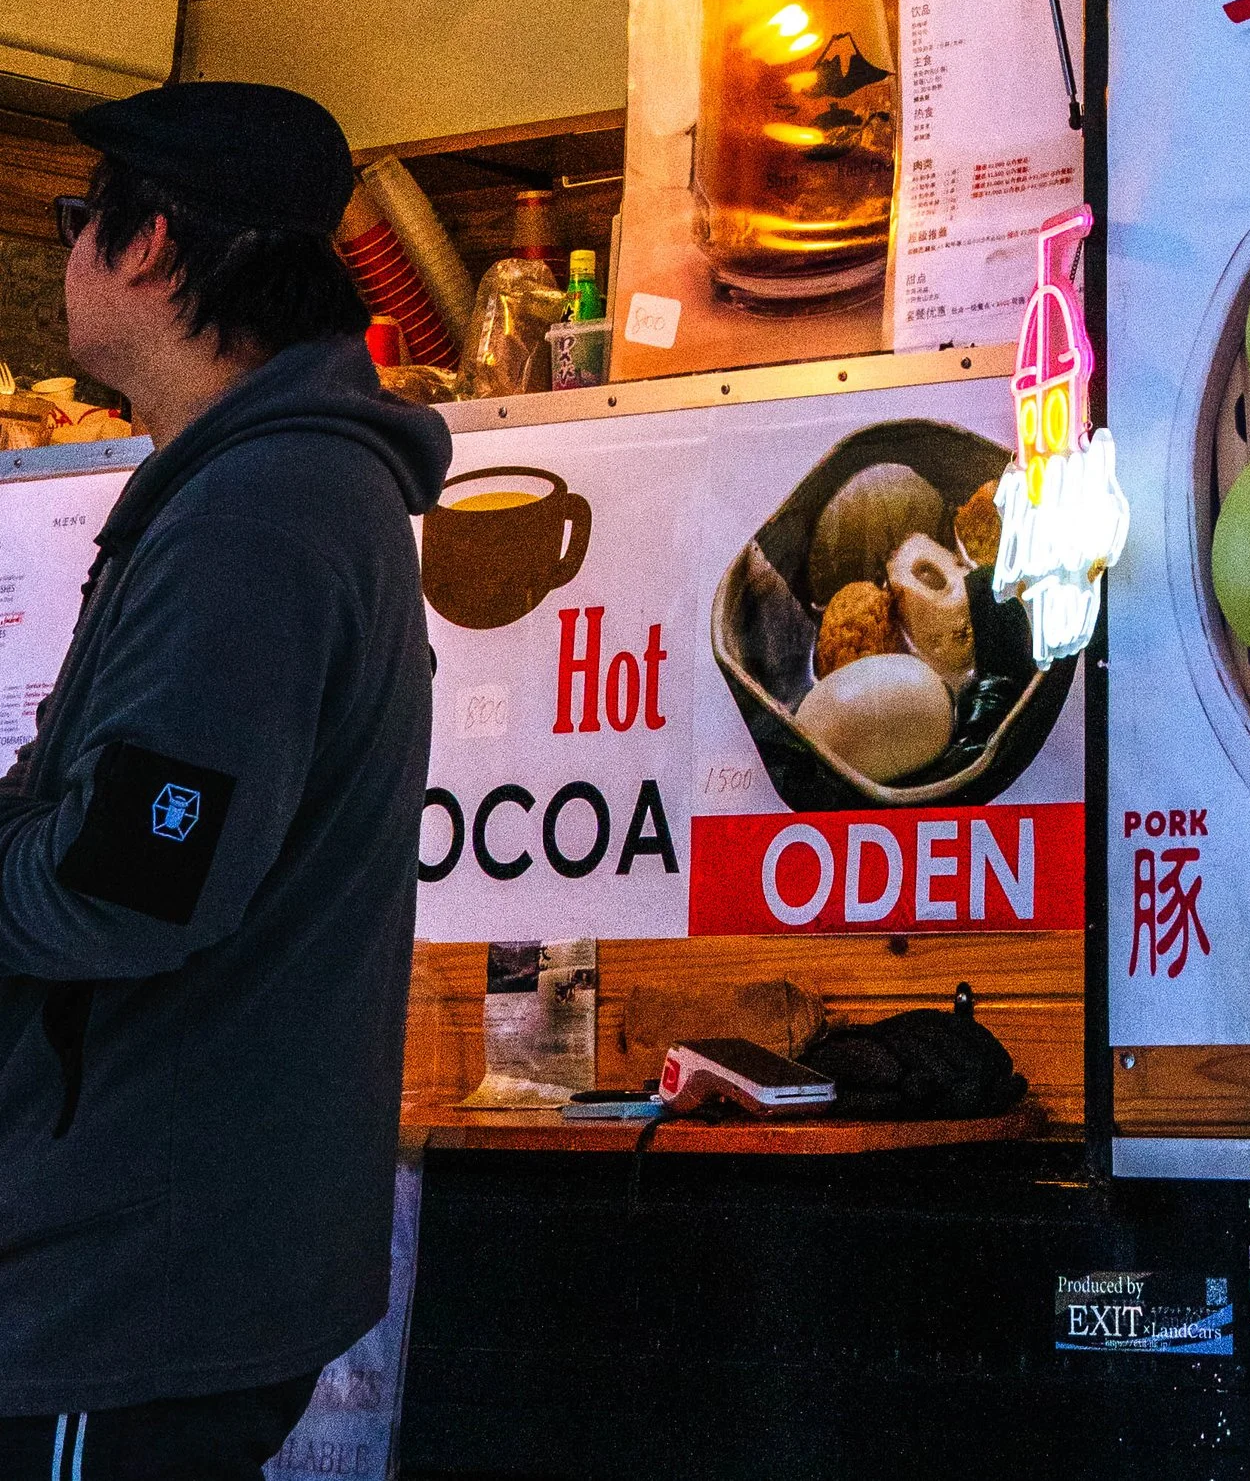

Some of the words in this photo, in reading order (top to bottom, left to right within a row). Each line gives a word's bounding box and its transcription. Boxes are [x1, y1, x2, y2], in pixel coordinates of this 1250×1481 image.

[552, 605, 667, 735] Hot
[418, 778, 680, 883] OCOA
[704, 767, 752, 795] 1500
[1123, 809, 1209, 839] PORK
[760, 817, 1035, 927] ODEN
[1128, 847, 1212, 979] 豚
[1058, 1276, 1123, 1294] Produced
[1127, 1276, 1145, 1300] by
